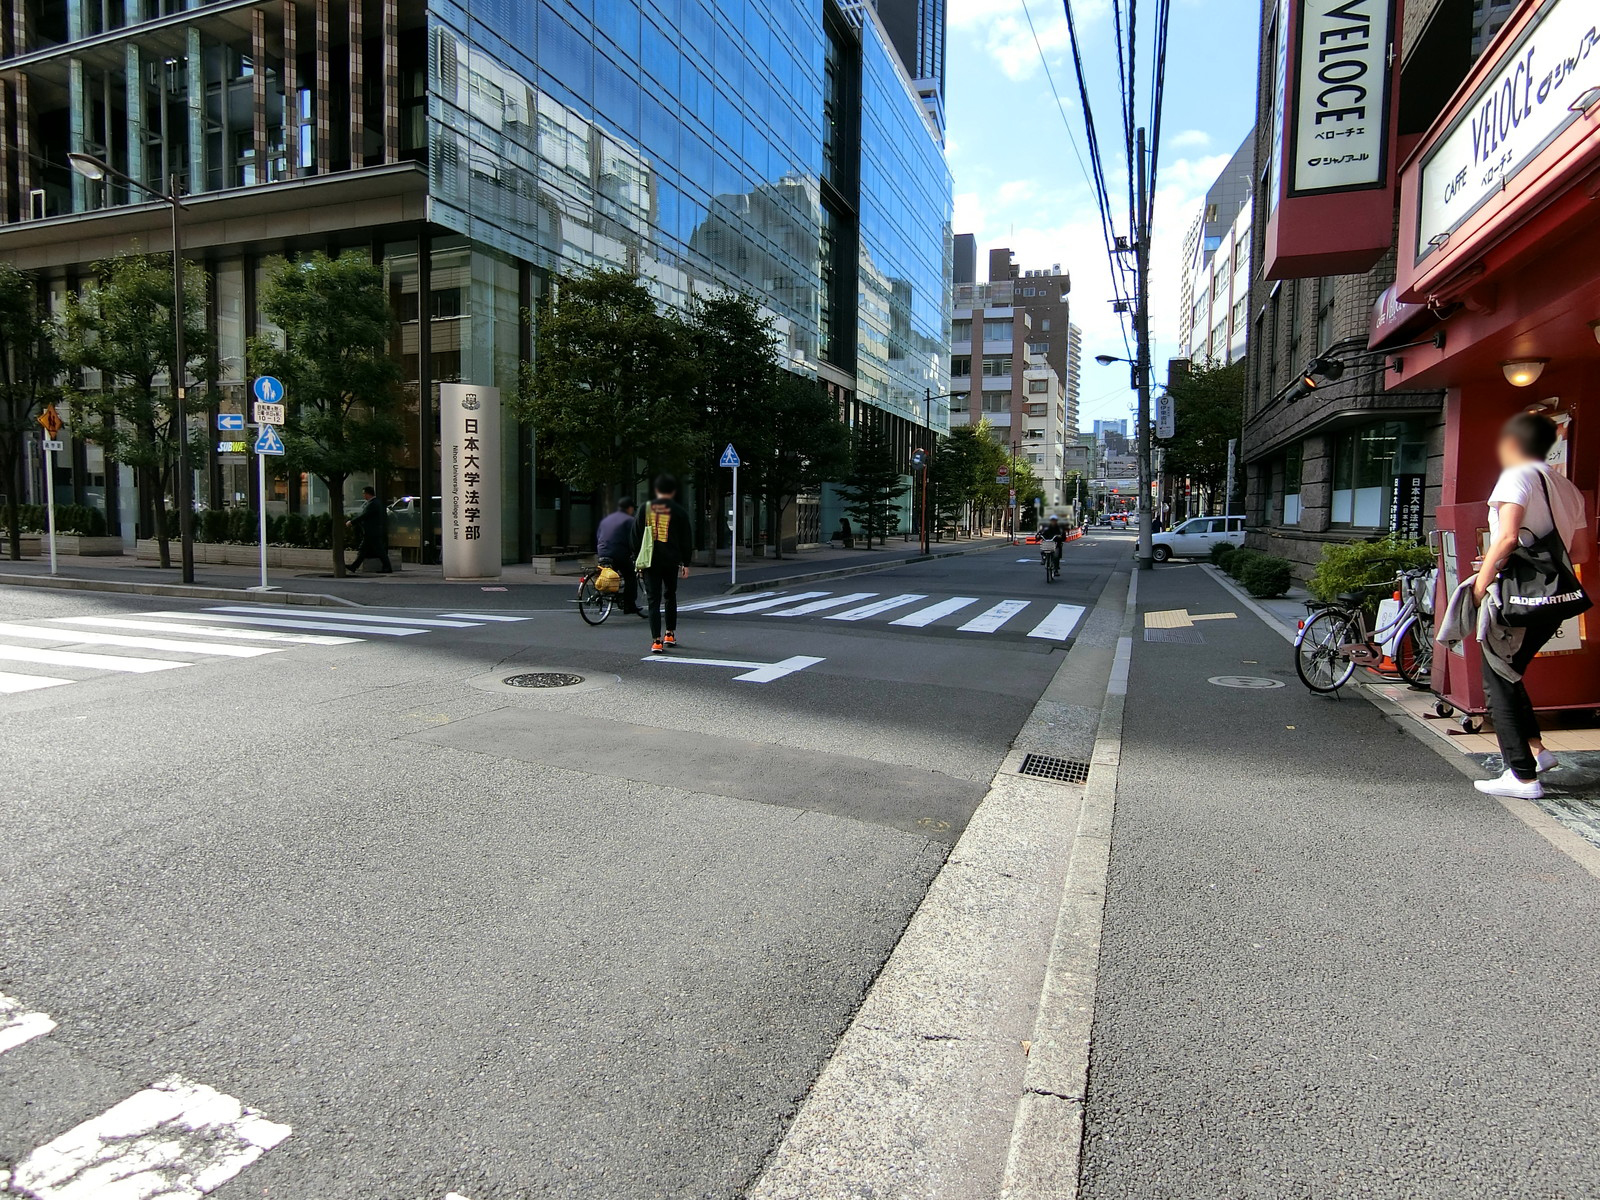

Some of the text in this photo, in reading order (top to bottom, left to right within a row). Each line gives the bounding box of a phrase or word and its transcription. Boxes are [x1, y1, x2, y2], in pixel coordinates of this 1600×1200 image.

[1315, 0, 1370, 125] VELOCE
[1315, 128, 1365, 139] ベローチェ
[1444, 45, 1535, 204] CAFFE VELOCE
[1323, 153, 1369, 165] シャノアール
[1480, 149, 1512, 187] ベローチェ
[217, 441, 247, 453] SUBWA
[464, 418, 481, 541] 日本大学法学部
[452, 495, 460, 520] College
[453, 519, 459, 527] of
